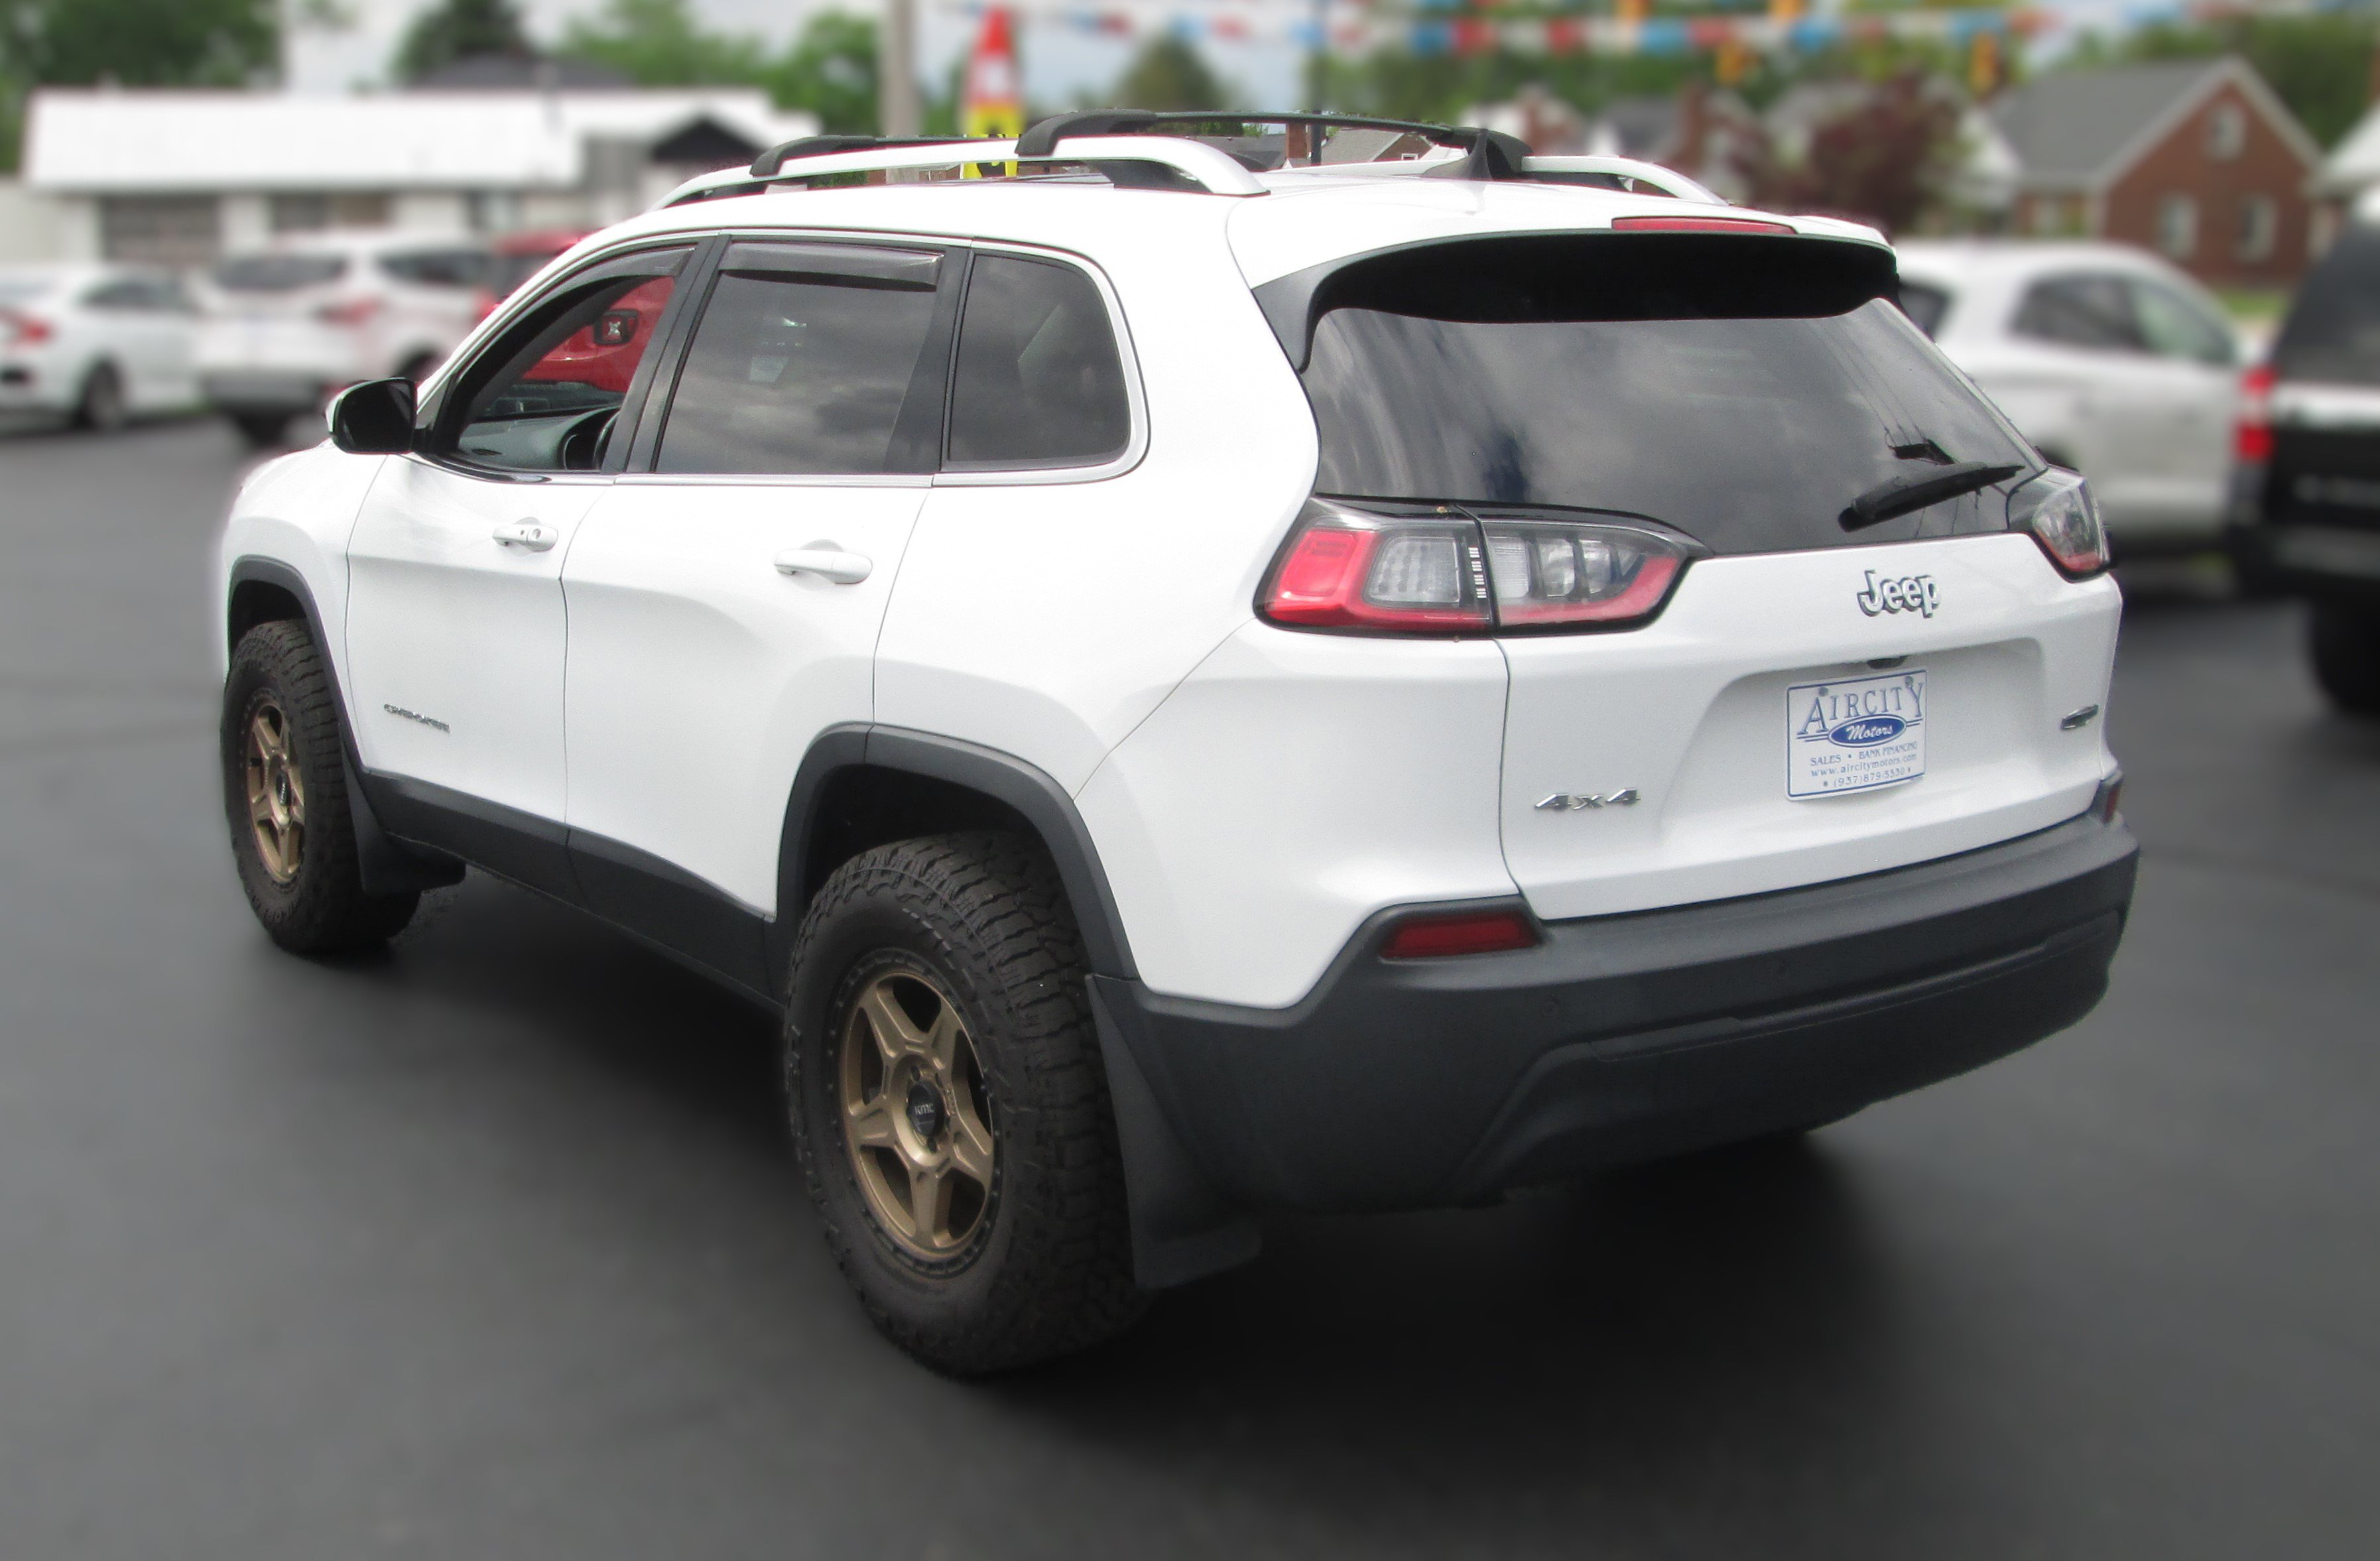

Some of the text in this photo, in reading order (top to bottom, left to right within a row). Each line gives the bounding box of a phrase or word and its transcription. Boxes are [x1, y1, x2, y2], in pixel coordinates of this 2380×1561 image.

[1857, 568, 1941, 619] Jeep
[1796, 682, 1924, 735] AIRCITY
[1846, 724, 1894, 741] Motors
[1810, 754, 1842, 767] SALES
[1859, 747, 1881, 759] BANK
[1811, 753, 1917, 777] www.aircitymotors.com
